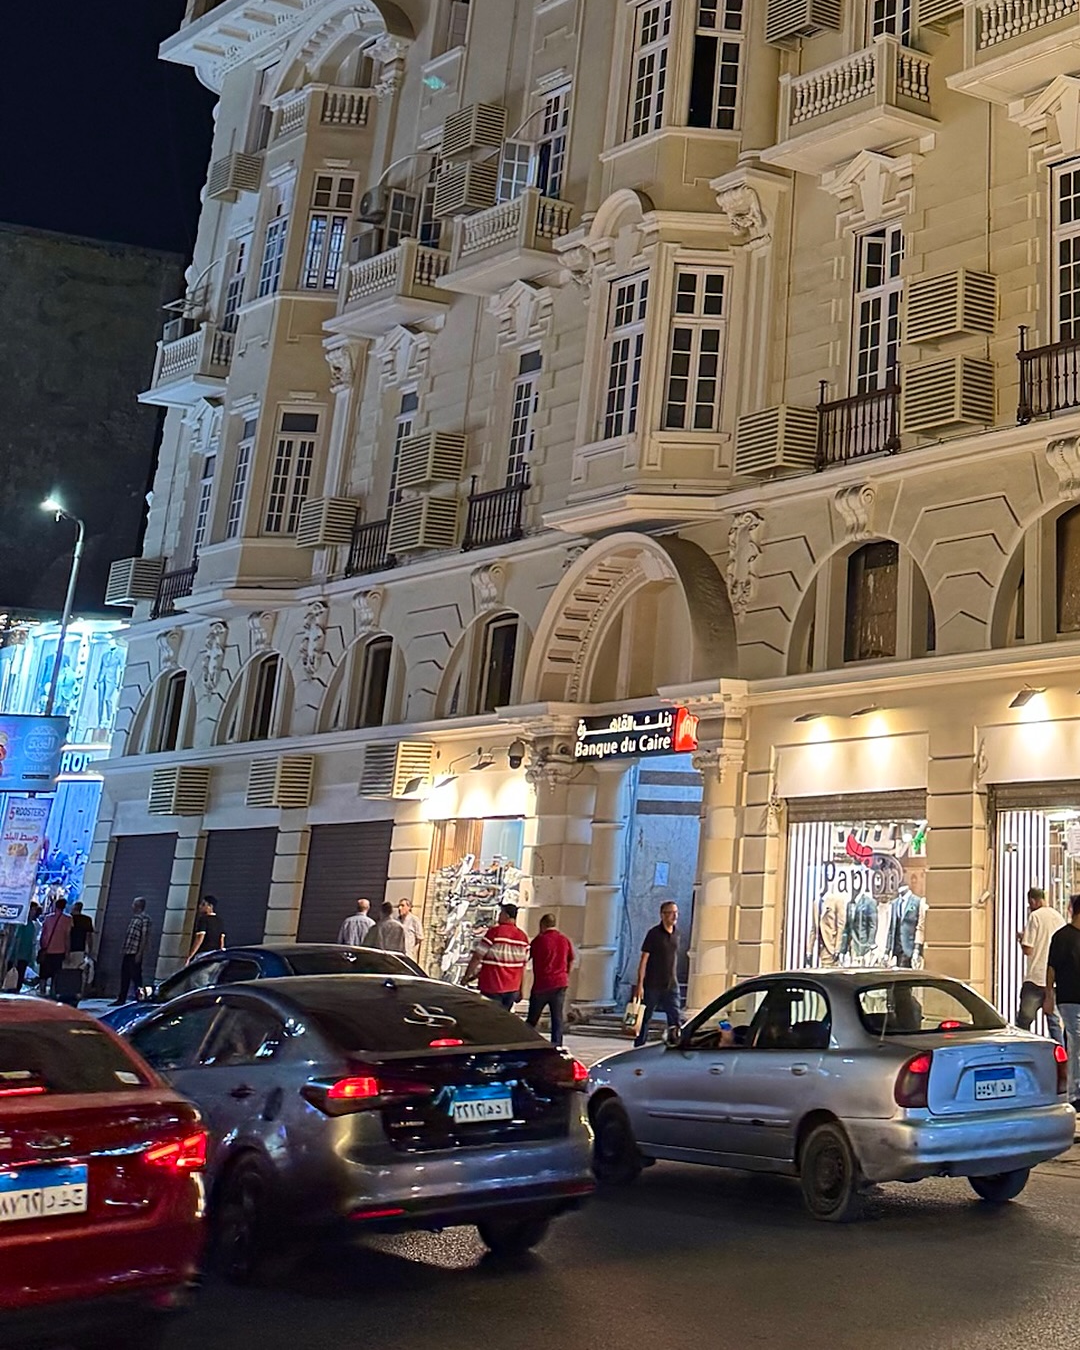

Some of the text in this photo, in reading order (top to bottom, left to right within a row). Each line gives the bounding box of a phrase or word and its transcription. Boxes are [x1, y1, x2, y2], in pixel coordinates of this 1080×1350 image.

[577, 711, 673, 741] بنك القاهرة
[574, 733, 671, 759] Banque du Caire
[820, 861, 899, 903] Papion
